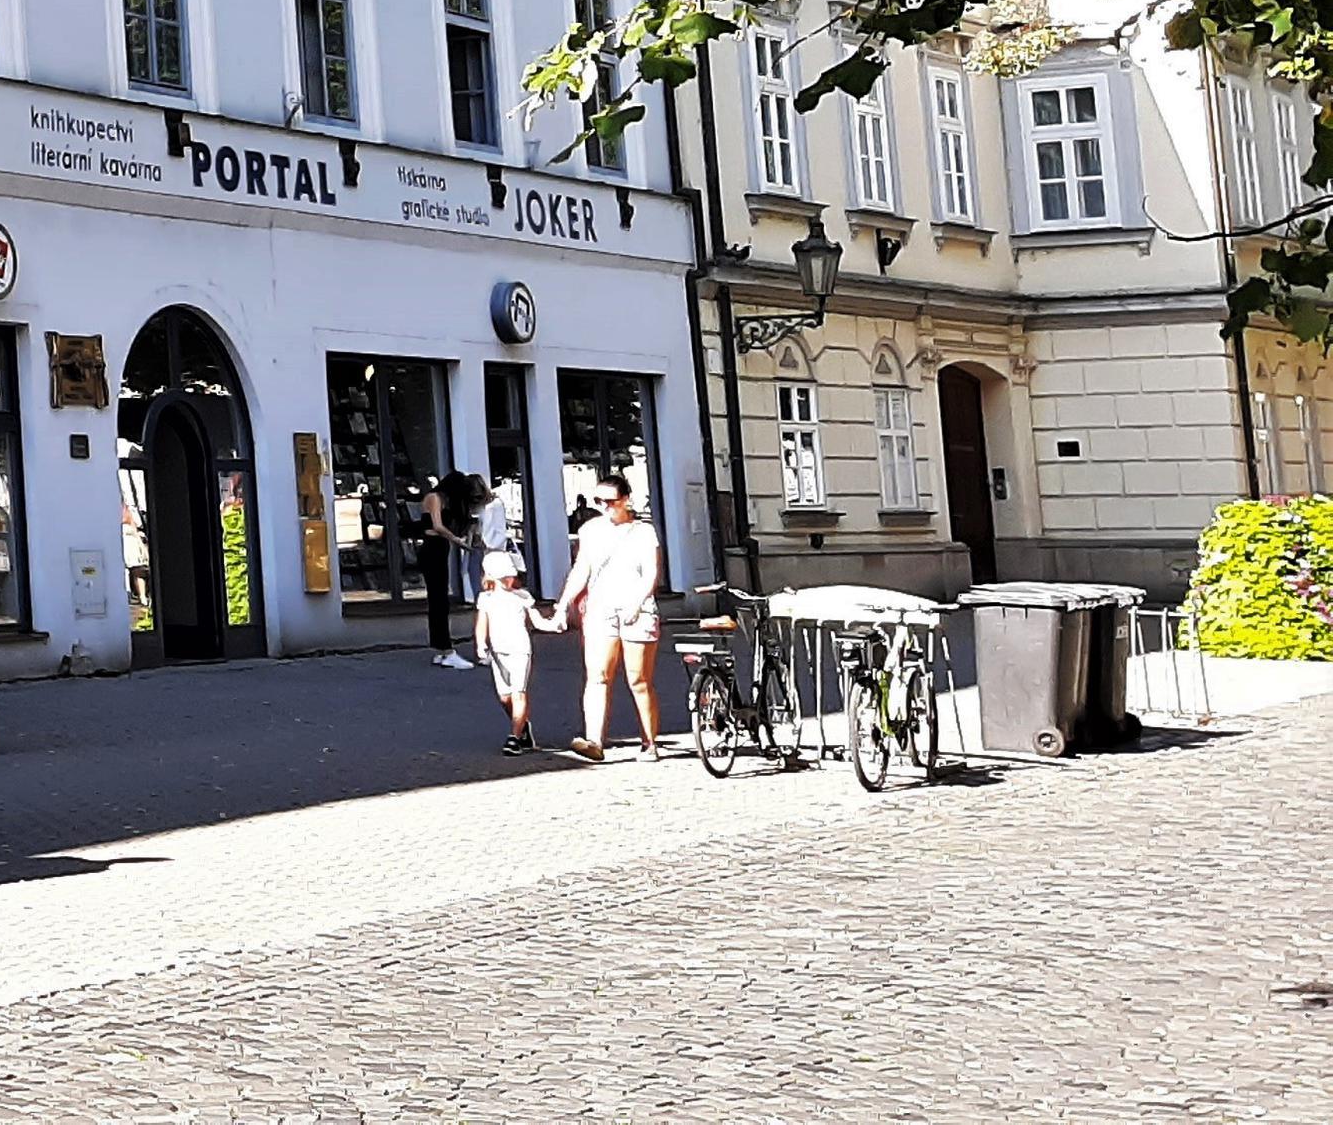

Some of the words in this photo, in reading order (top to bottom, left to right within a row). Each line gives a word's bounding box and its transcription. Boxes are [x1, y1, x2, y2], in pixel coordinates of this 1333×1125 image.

[31, 141, 92, 171] literární
[100, 152, 162, 181] kavárna
[191, 141, 336, 206] PORTAL
[514, 188, 597, 242] JOKER
